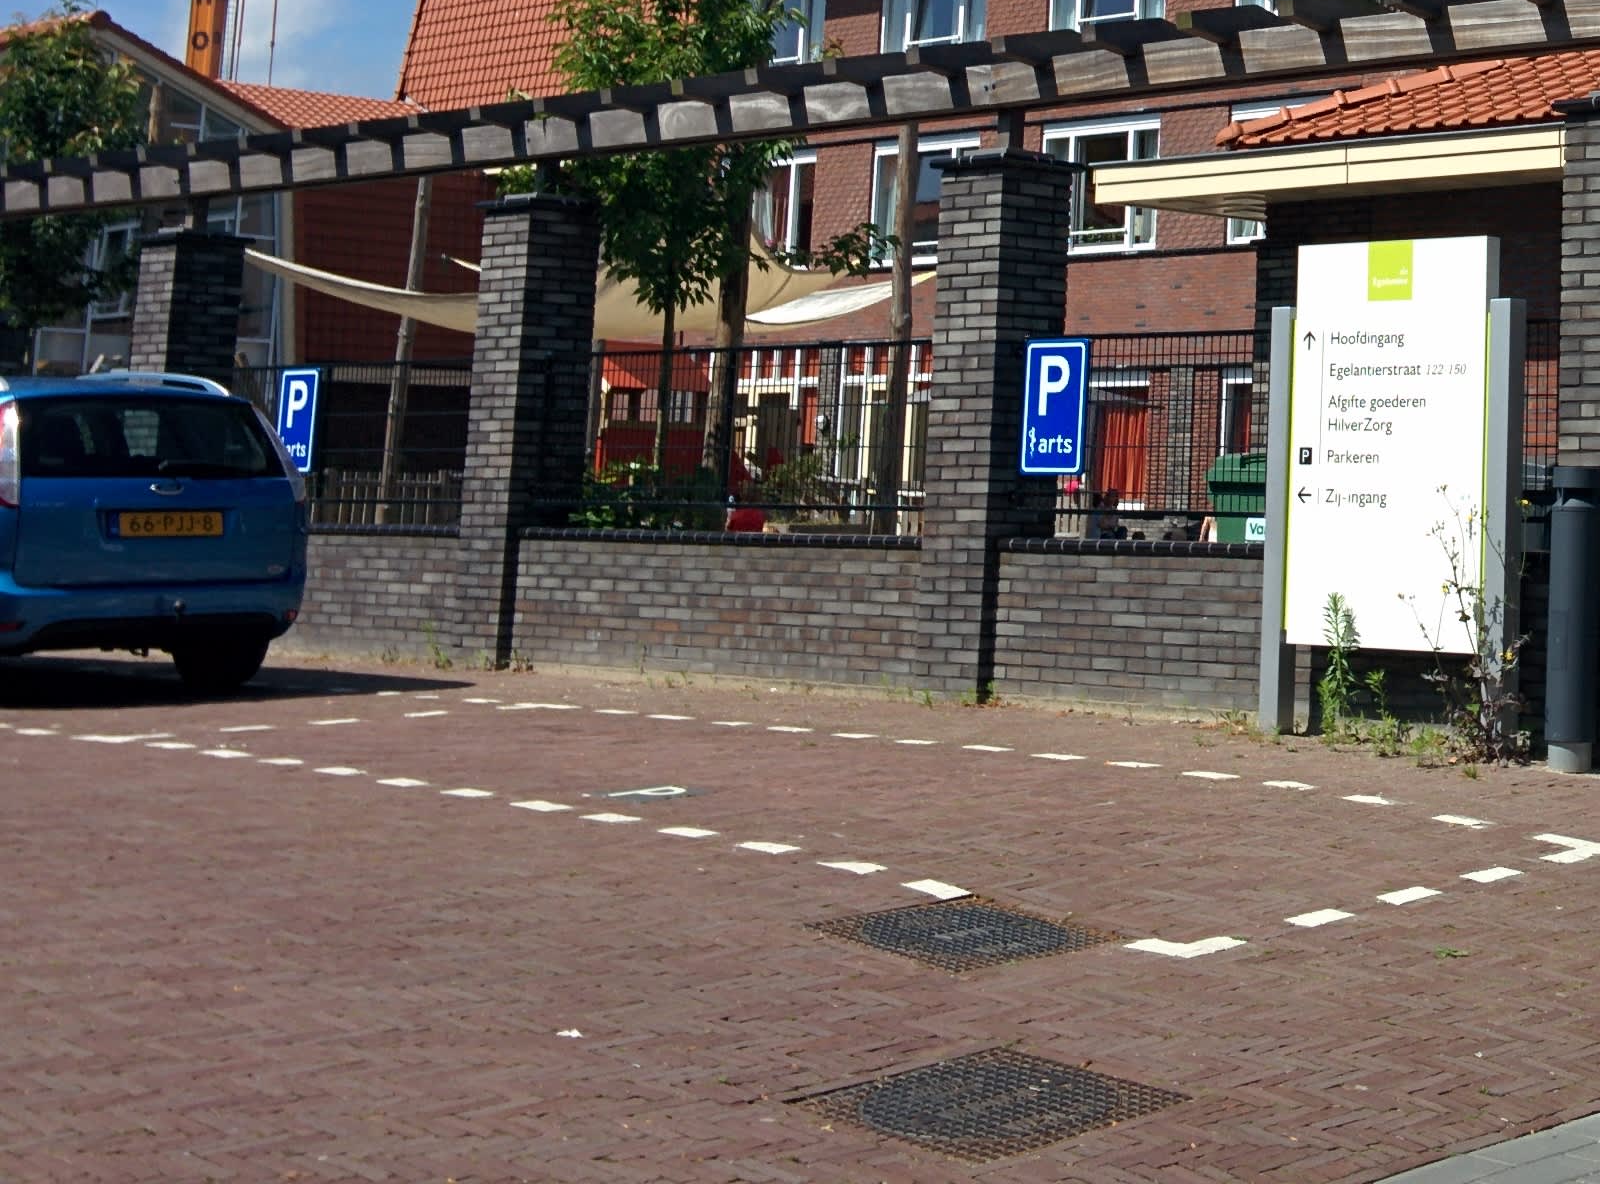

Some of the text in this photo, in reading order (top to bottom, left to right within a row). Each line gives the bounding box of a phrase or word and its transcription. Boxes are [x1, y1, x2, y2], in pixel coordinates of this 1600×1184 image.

[1330, 330, 1405, 348] Hoofdingang
[1329, 362, 1422, 381] Egelantierstraat
[1037, 354, 1071, 417] P
[286, 379, 309, 429] P
[1327, 394, 1427, 413] Afgifte goederen
[1037, 434, 1073, 454] arts
[1301, 448, 1380, 464] P Parkeren
